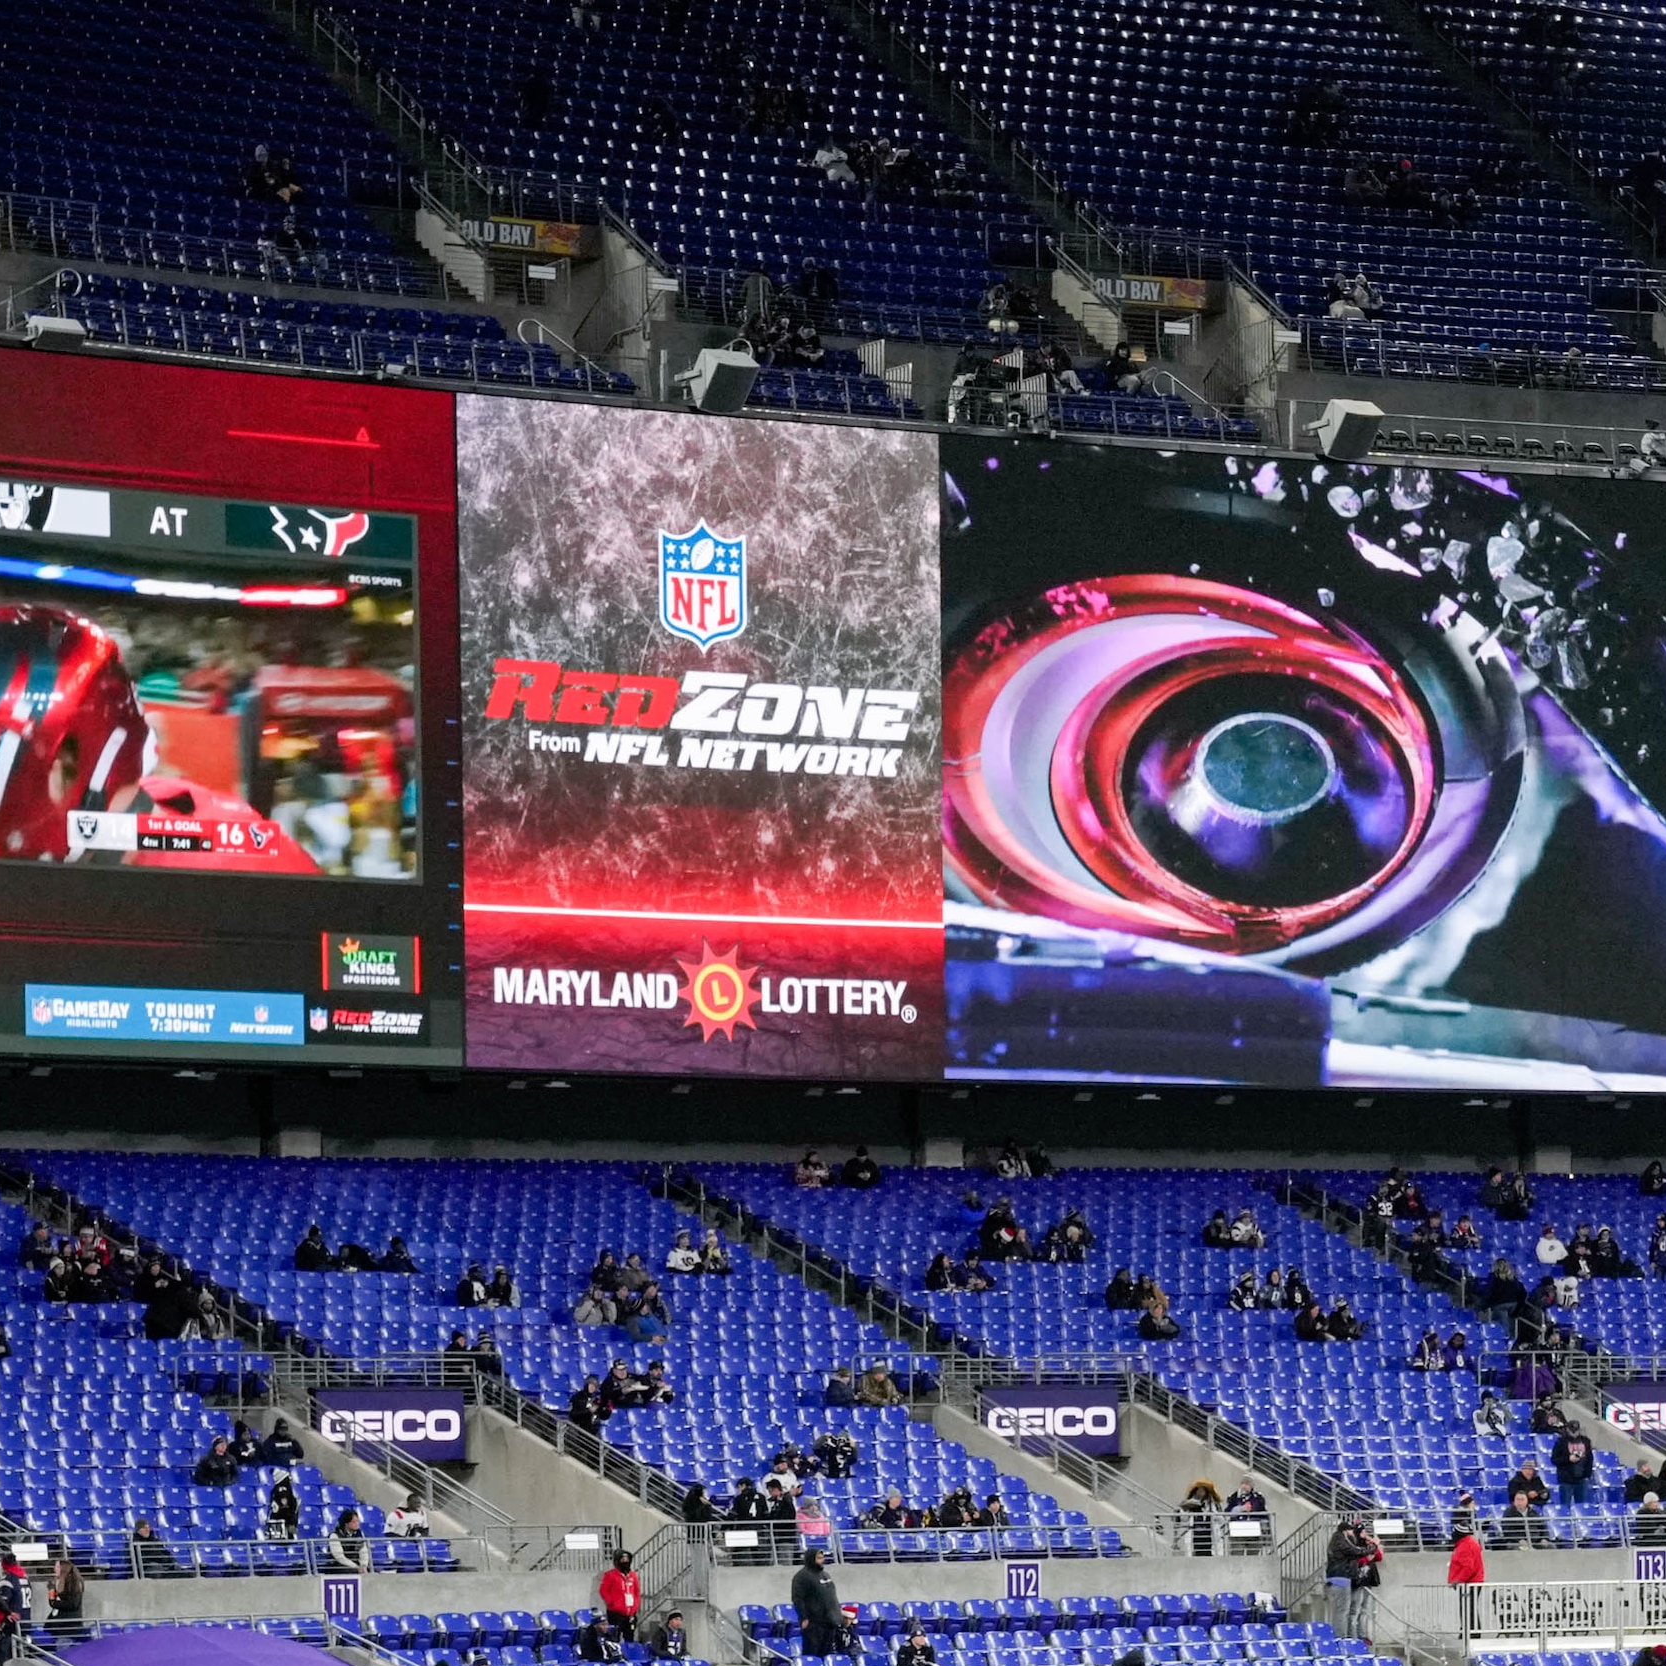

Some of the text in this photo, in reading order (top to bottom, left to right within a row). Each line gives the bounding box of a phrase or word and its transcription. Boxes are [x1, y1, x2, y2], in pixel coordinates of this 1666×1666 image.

[499, 222, 532, 247] BAY
[1130, 280, 1162, 301] BAY
[149, 505, 189, 539] AT
[671, 577, 736, 632] NFL
[485, 657, 920, 742] REDZONE
[529, 730, 902, 778] From NFL NETWORK
[174, 821, 203, 832] GOAL
[217, 823, 245, 845] 16
[343, 949, 397, 965] DRAFT
[349, 963, 396, 976] KINGS
[342, 974, 401, 986] SPORTSBOOK
[493, 966, 678, 1010] MARYLAND
[760, 976, 907, 1016] LOTTERY
[53, 998, 130, 1019] GAMEDAY
[145, 1001, 216, 1020] TONIGHT
[230, 1021, 294, 1036] NETWORK
[370, 1024, 420, 1036] NETWORK
[320, 1408, 461, 1442] GEICO
[987, 1406, 1116, 1437] GEICO
[1637, 1554, 1665, 1582] 113
[1008, 1567, 1038, 1598] 112
[328, 1583, 356, 1616] 111
